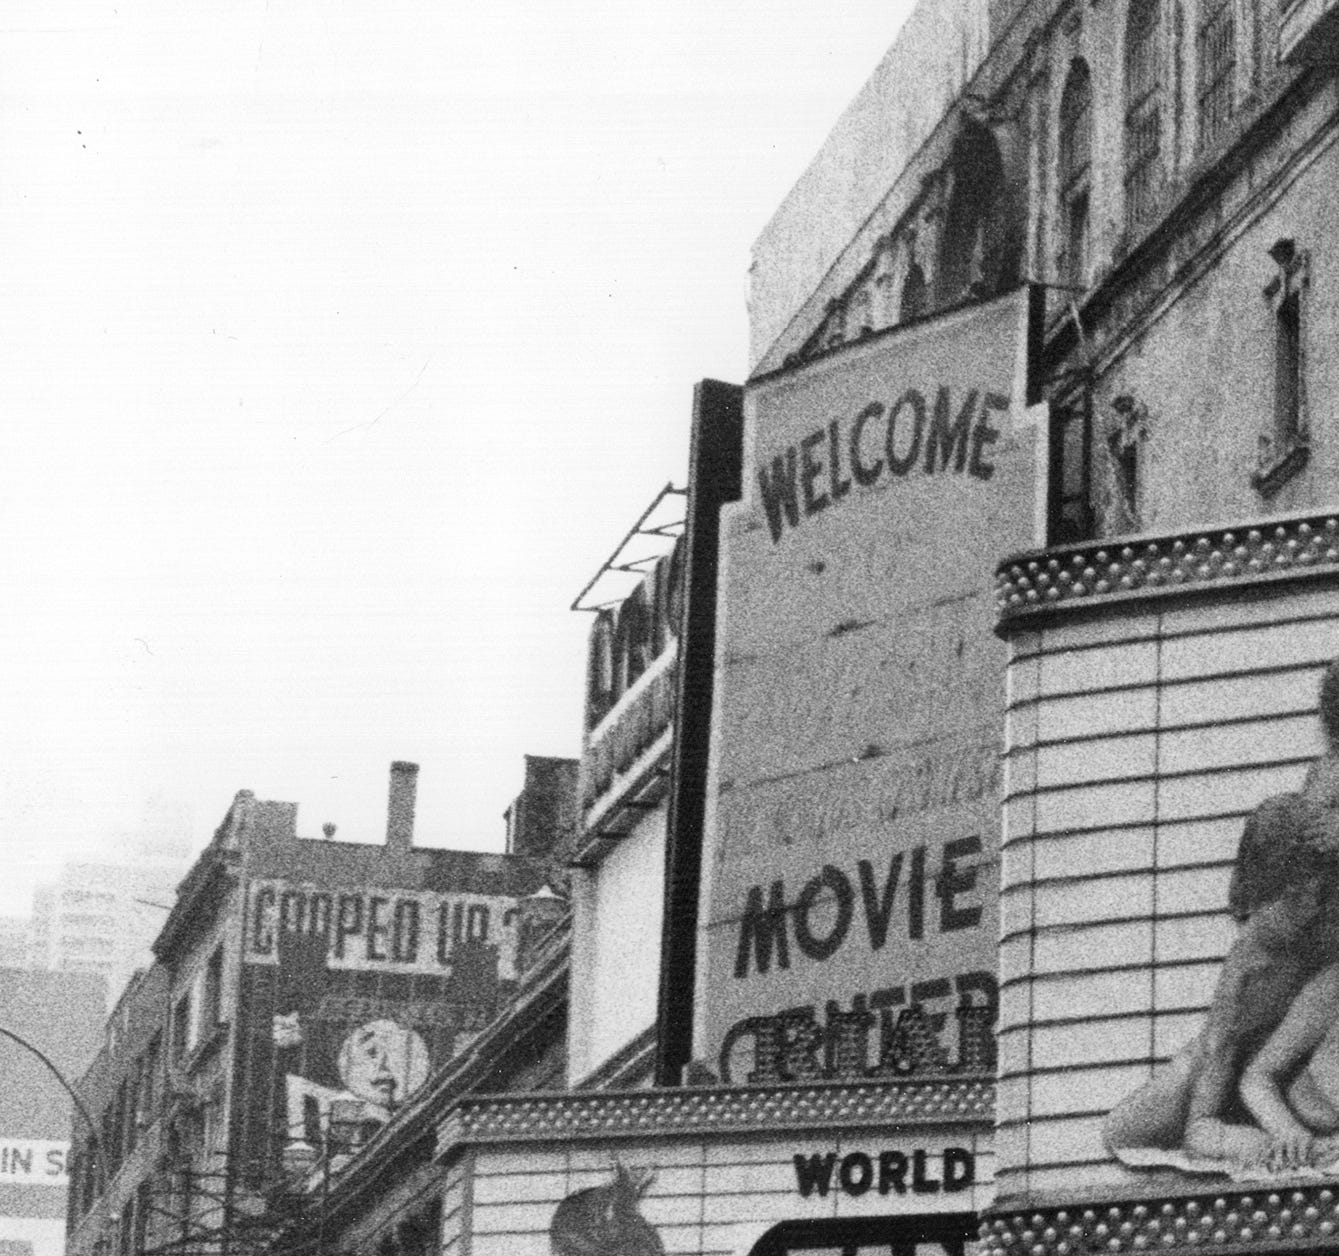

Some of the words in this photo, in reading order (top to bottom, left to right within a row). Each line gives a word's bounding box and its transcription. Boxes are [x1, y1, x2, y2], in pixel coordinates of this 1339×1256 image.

[757, 385, 1010, 545] WELCOME
[733, 834, 983, 979] MOVIE
[793, 1147, 976, 1198] WORLD
